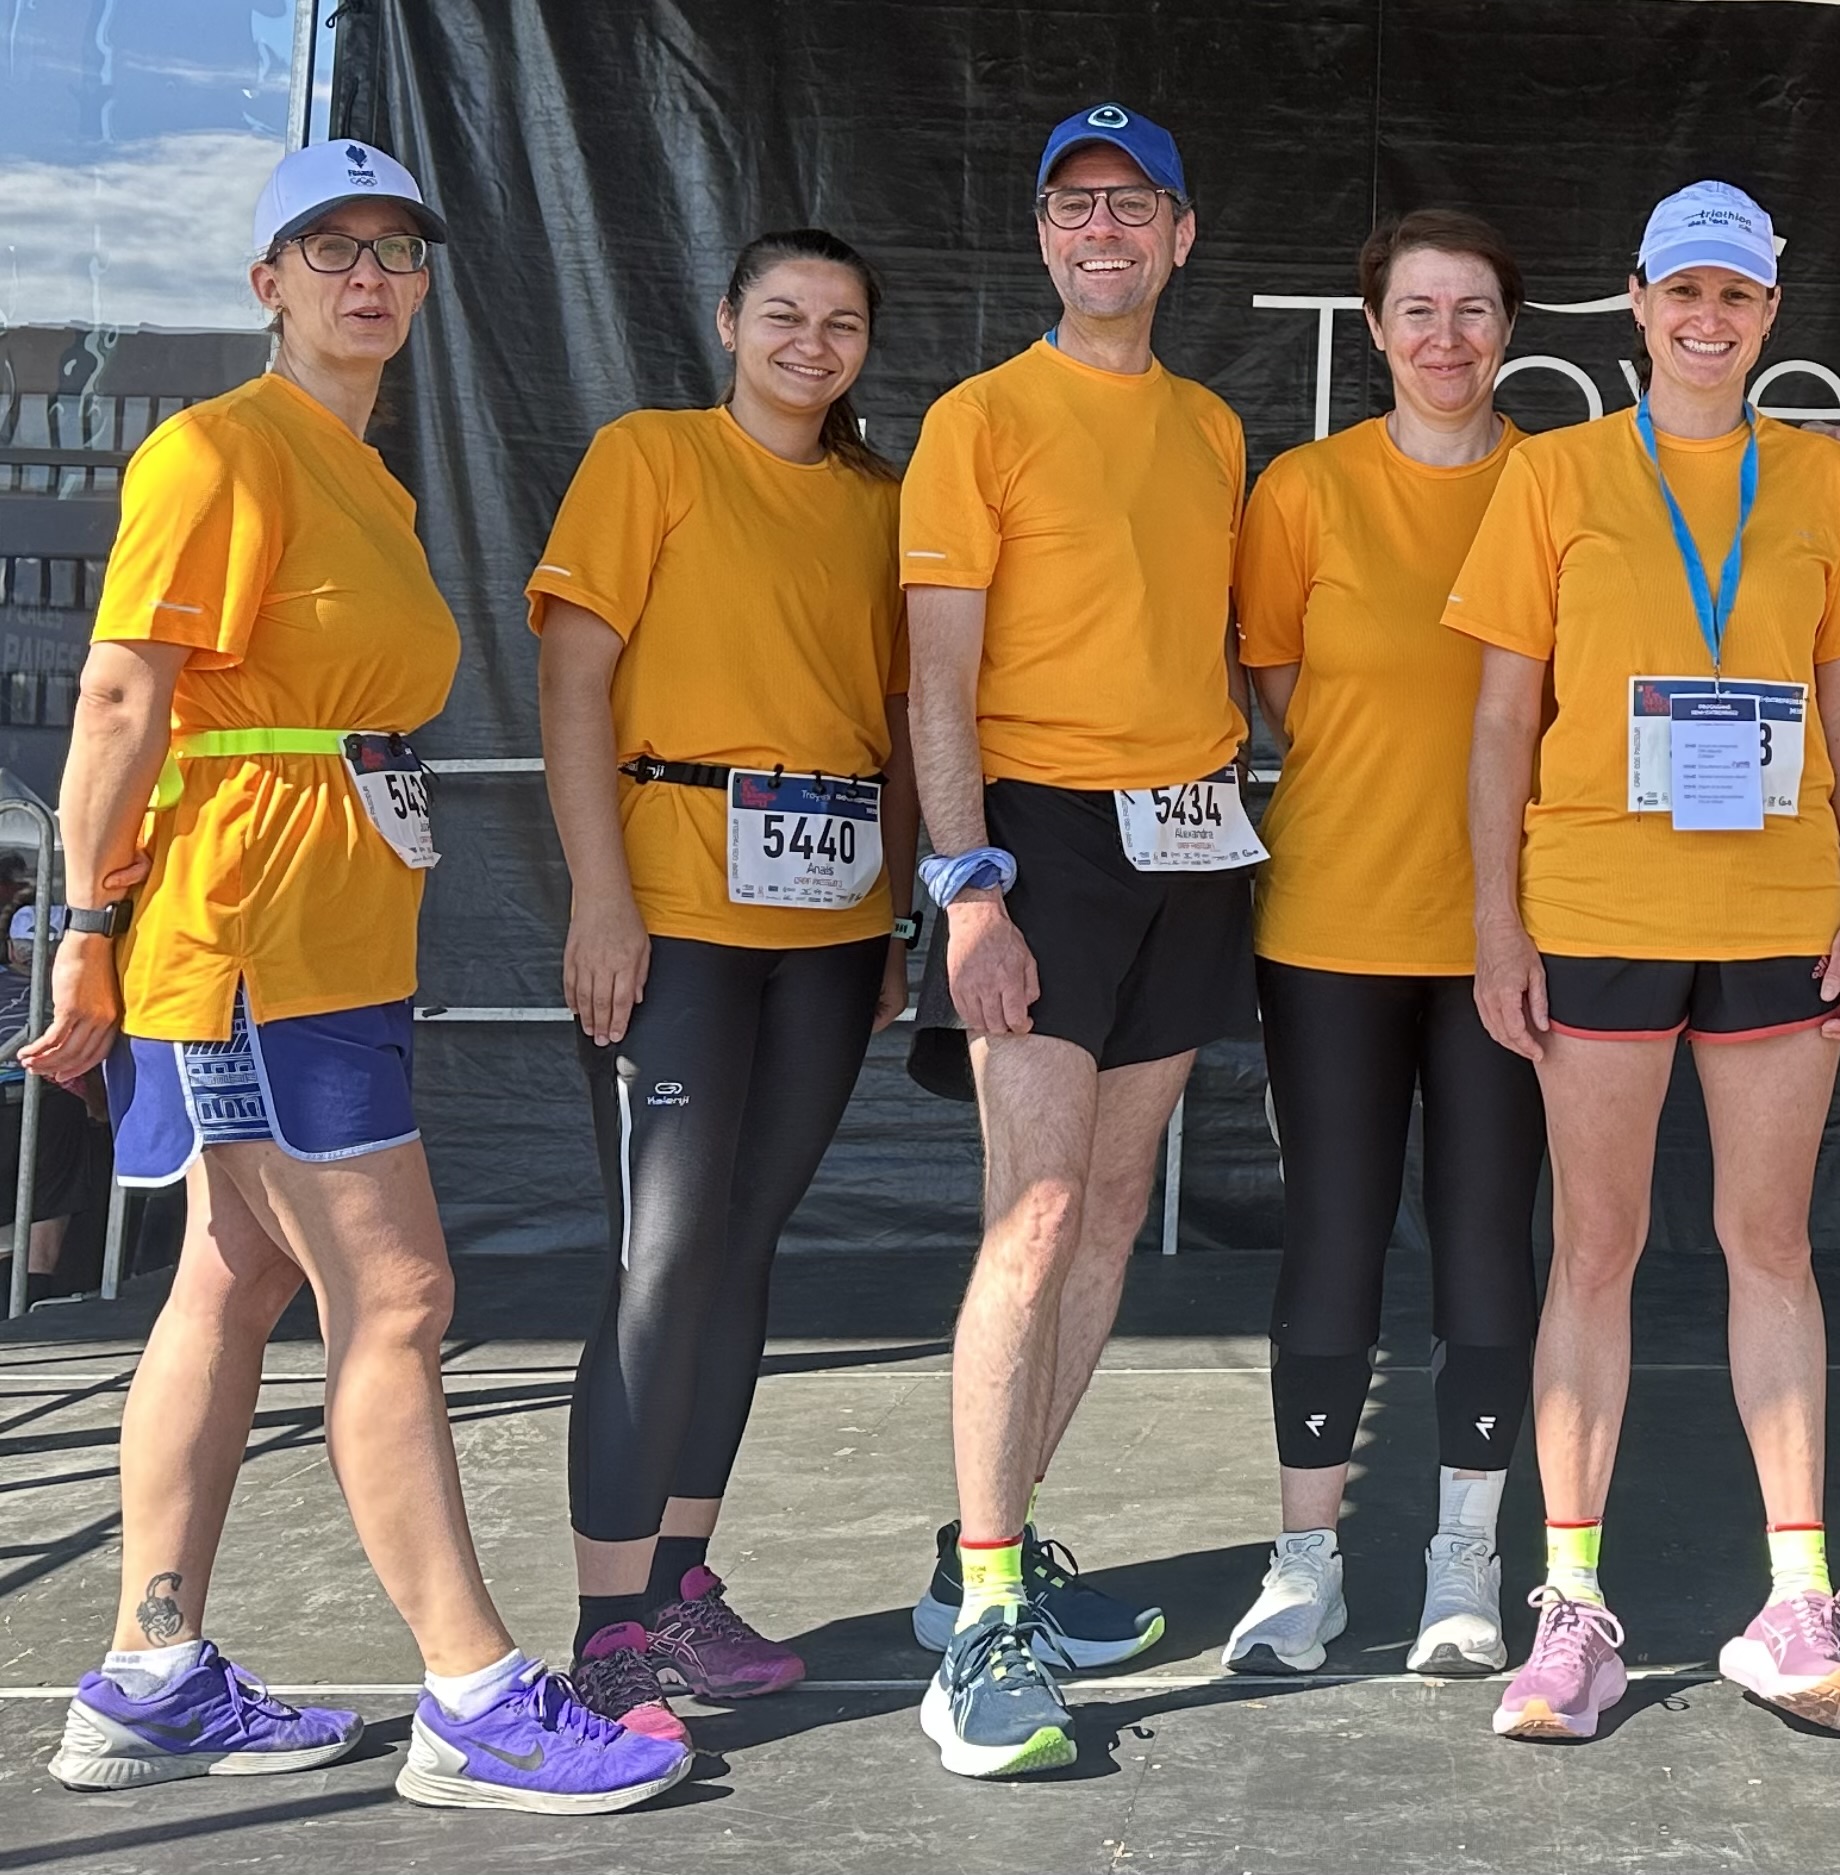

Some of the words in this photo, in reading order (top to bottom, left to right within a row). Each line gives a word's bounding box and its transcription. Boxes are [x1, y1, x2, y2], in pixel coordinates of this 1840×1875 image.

[1700, 209, 1752, 227] triathlon
[385, 774, 429, 819] 543
[1151, 784, 1222, 826] 5434
[764, 814, 855, 864] 5440
[647, 1096, 690, 1106] Kalenji
